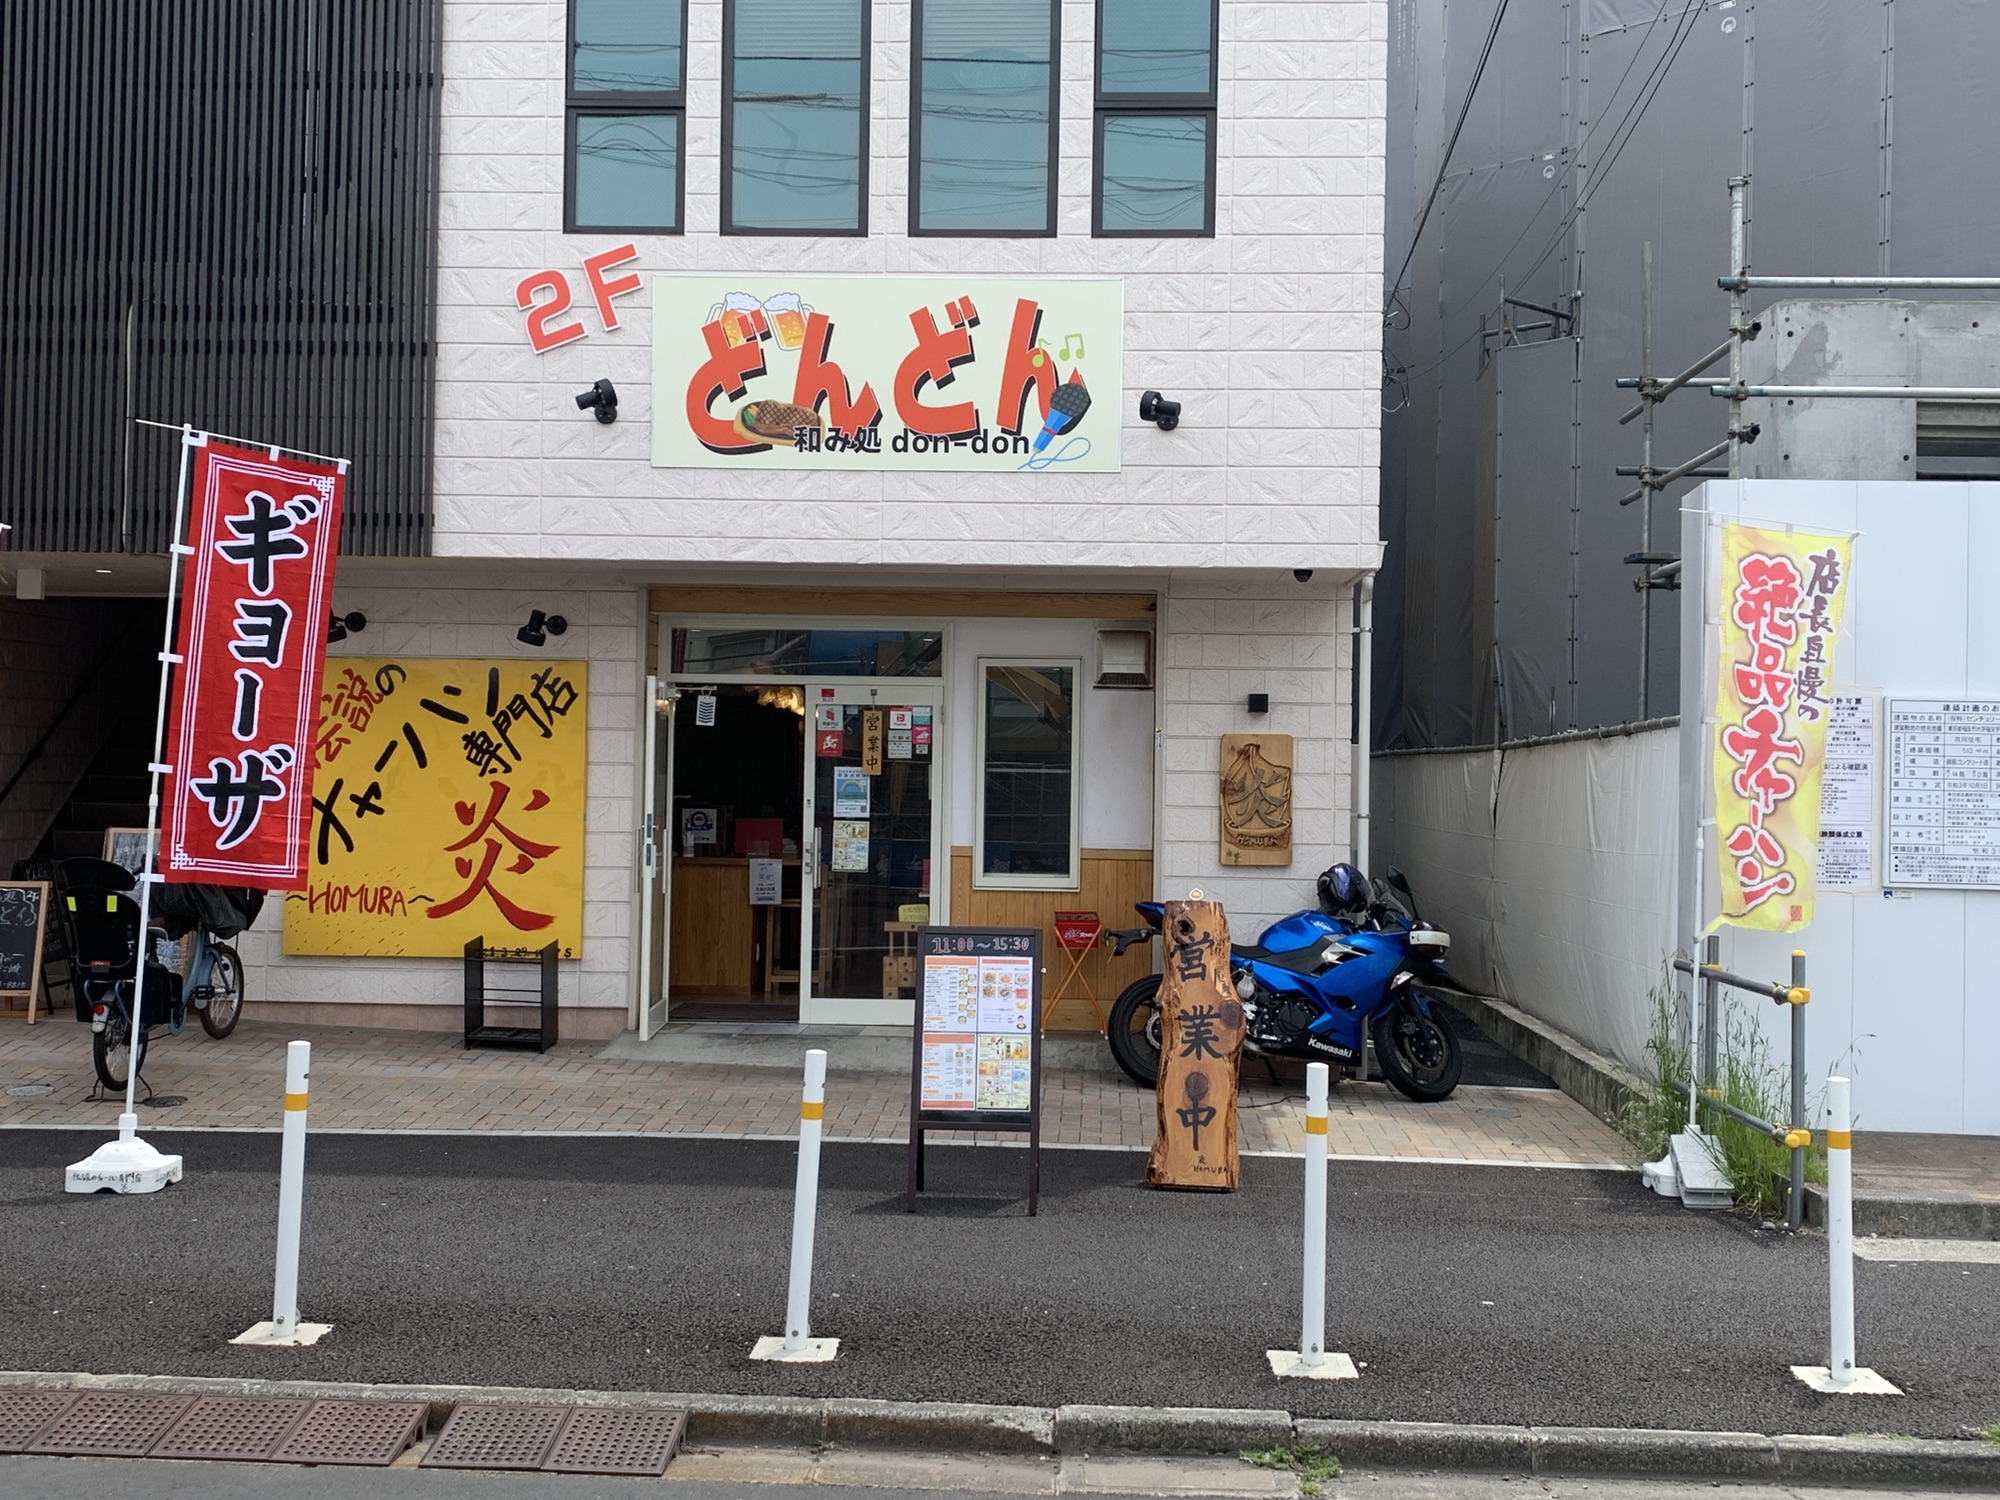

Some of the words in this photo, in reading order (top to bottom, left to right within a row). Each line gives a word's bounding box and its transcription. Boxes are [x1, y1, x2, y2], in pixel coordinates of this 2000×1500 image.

[514, 242, 644, 355] 2F
[686, 295, 1091, 455] どんどん
[794, 426, 881, 454] 和み処
[891, 428, 1030, 454] don-don
[190, 491, 320, 851] ギョーザ
[1794, 549, 1841, 721] 店長自慢の
[462, 667, 579, 777] 専門店
[866, 715, 880, 771] 営業中
[1725, 556, 1803, 909] 絶品チャーハン
[425, 780, 562, 931] 炎
[1171, 932, 1225, 1151] 営業中
[1308, 1036, 1353, 1059] Kawasaki
